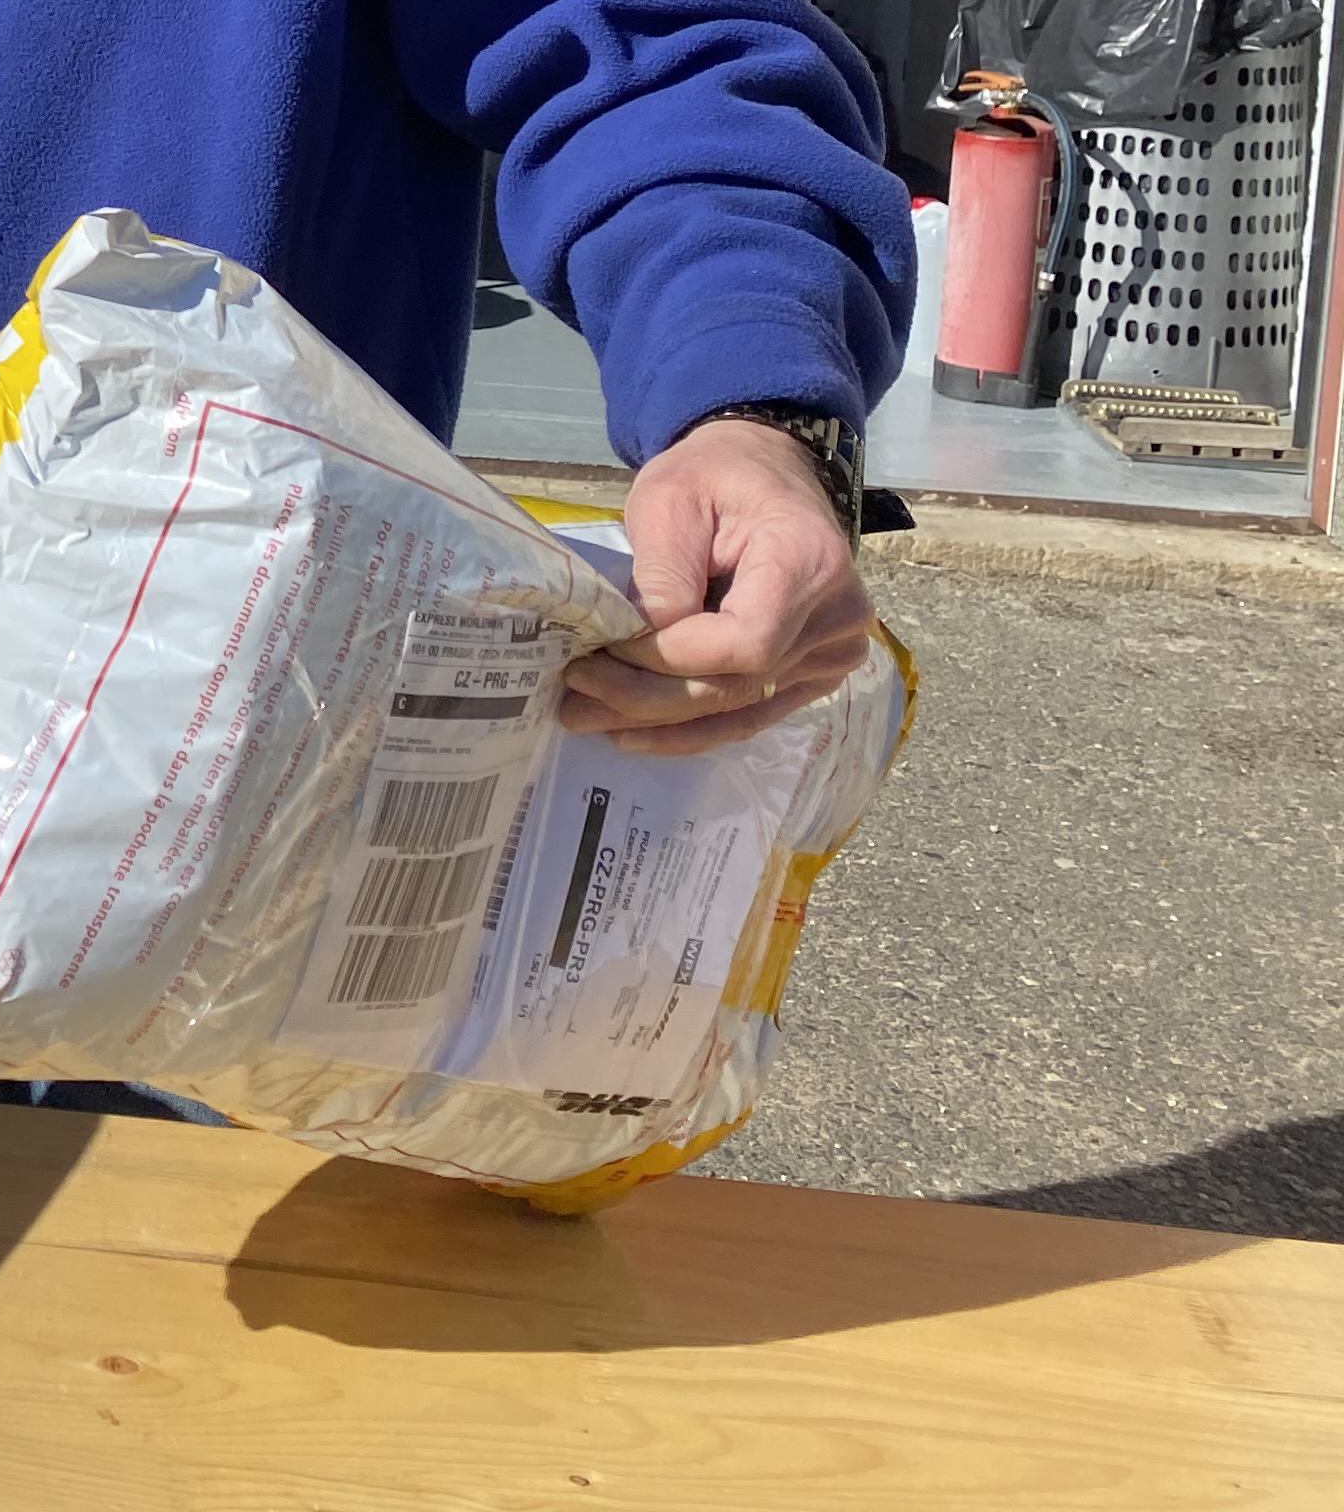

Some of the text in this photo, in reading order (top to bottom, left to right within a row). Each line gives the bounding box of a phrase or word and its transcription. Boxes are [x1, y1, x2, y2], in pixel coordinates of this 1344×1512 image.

[315, 492, 334, 513] et
[260, 536, 285, 564] les
[302, 516, 329, 550] que
[370, 518, 394, 549] Por
[293, 552, 315, 578] les
[354, 553, 388, 601] favor
[424, 547, 458, 617] Por fav
[218, 566, 273, 659] documents
[332, 604, 370, 664] inserte
[414, 612, 457, 627] EXPRESS
[242, 581, 307, 695] marchandises
[370, 628, 390, 653] de
[411, 644, 425, 653] 101
[428, 644, 439, 656] 00
[175, 502, 359, 890] Veuillez vous assurer que la documentation est
[321, 666, 344, 694] los
[178, 662, 231, 747] complétés
[221, 697, 257, 751] soient
[20, 699, 71, 778] Maximum
[161, 749, 192, 792] dans
[201, 752, 231, 792] bien
[151, 792, 172, 813] la
[591, 791, 606, 806] C
[112, 810, 159, 883] pochette
[228, 800, 279, 885] completos
[622, 826, 640, 861] Czech
[630, 830, 651, 876] PRAGUE
[565, 847, 616, 984] CZ-PRG-PR3
[56, 884, 120, 993] transparente
[675, 940, 700, 984] WPX
